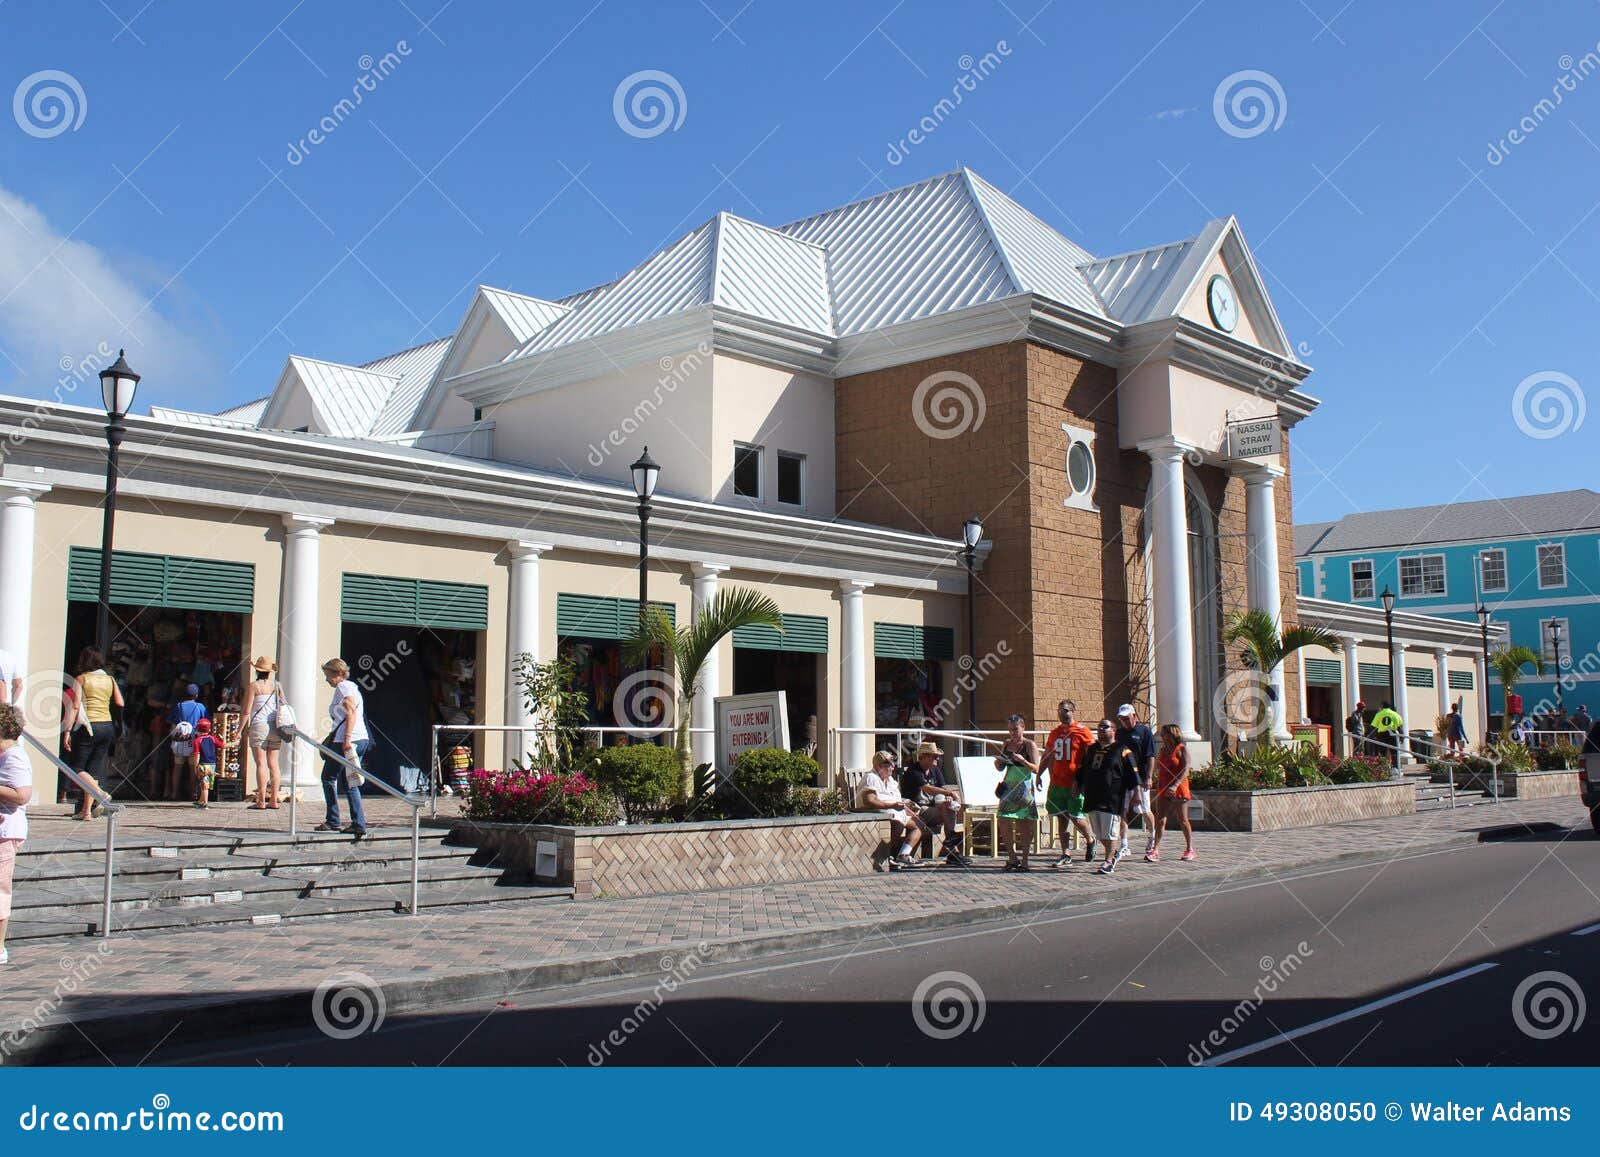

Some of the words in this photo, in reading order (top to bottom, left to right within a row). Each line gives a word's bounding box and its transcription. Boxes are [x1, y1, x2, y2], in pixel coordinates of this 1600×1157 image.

[1237, 423, 1273, 434] NASSAU
[1240, 434, 1271, 446] STRAW
[1238, 445, 1273, 456] MARKET
[729, 713, 742, 727] YOU
[743, 712, 755, 726] ARE
[755, 711, 770, 726] NOW
[732, 732, 762, 747] ENTERING
[1054, 737, 1072, 760] 91
